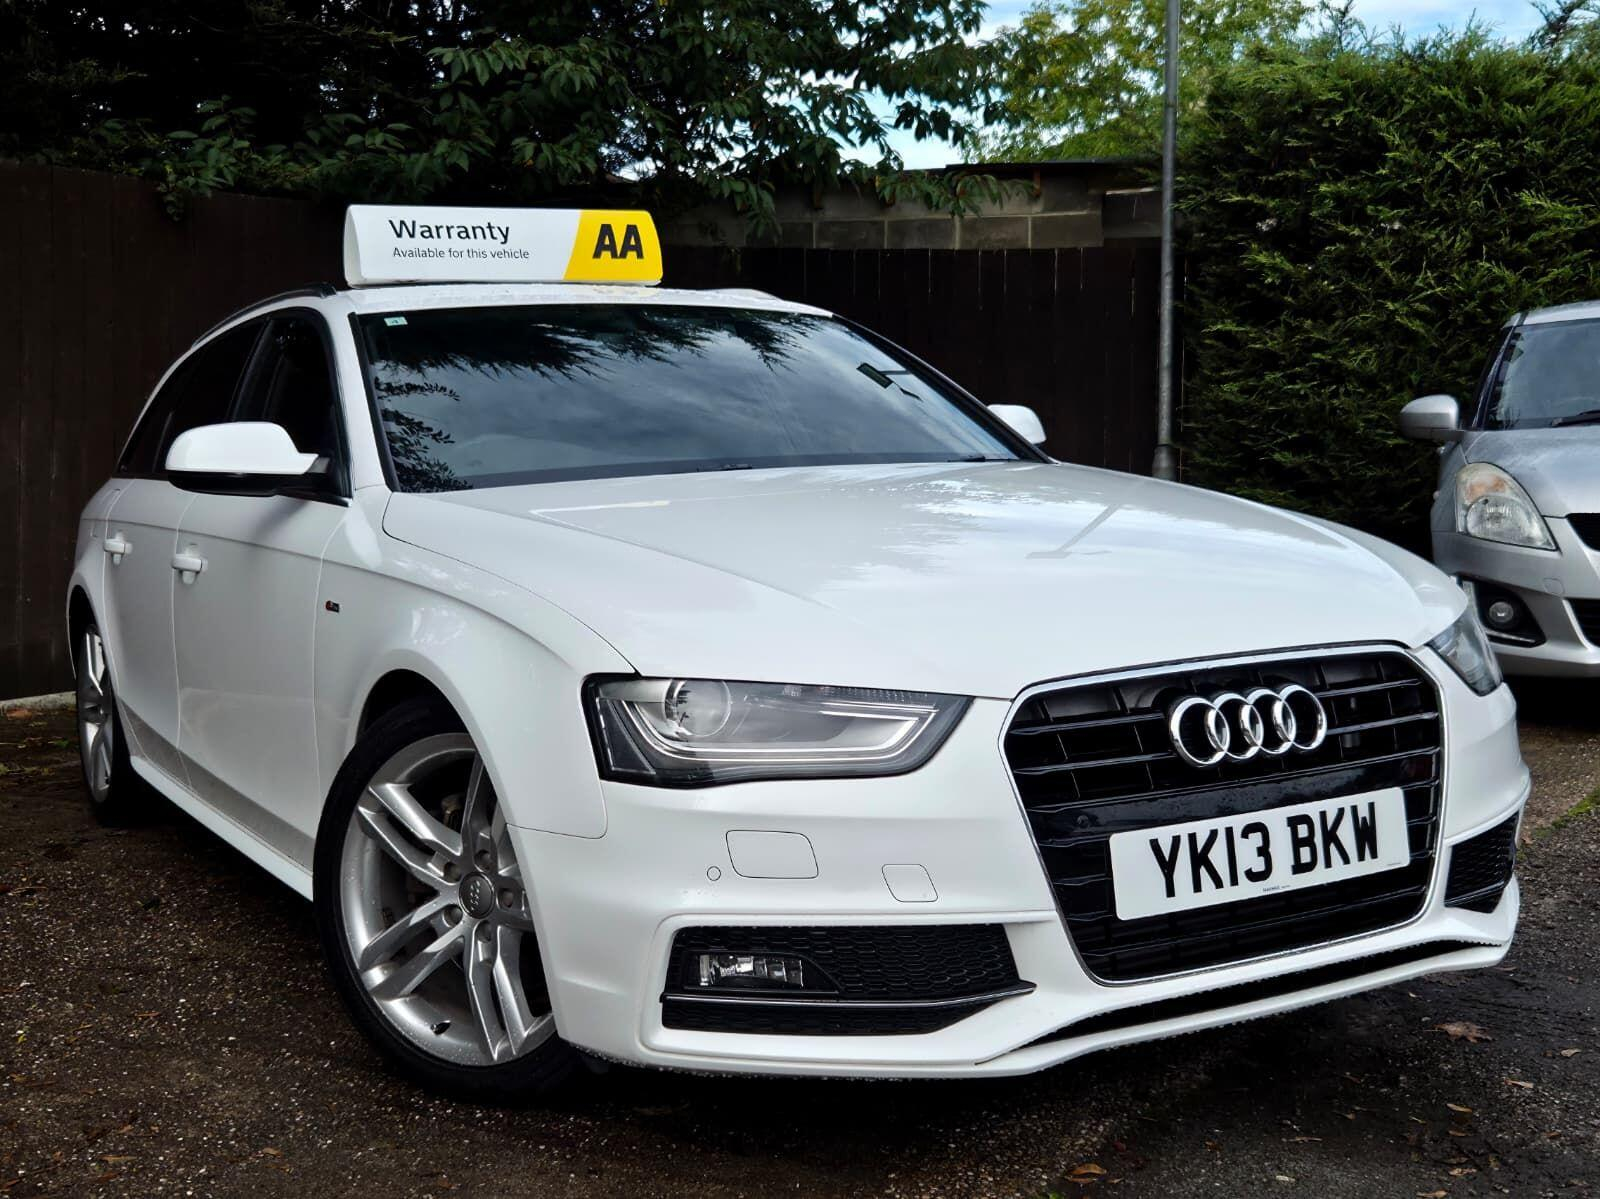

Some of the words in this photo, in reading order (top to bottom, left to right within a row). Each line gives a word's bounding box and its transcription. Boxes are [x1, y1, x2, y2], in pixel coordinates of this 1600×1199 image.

[389, 219, 510, 244] Warranty
[592, 224, 644, 259] AA
[393, 247, 445, 258] Available
[448, 247, 464, 259] for
[467, 247, 488, 259] this
[490, 248, 530, 259] vehicle
[1149, 821, 1273, 898] YK13
[1286, 801, 1378, 876] BKW
